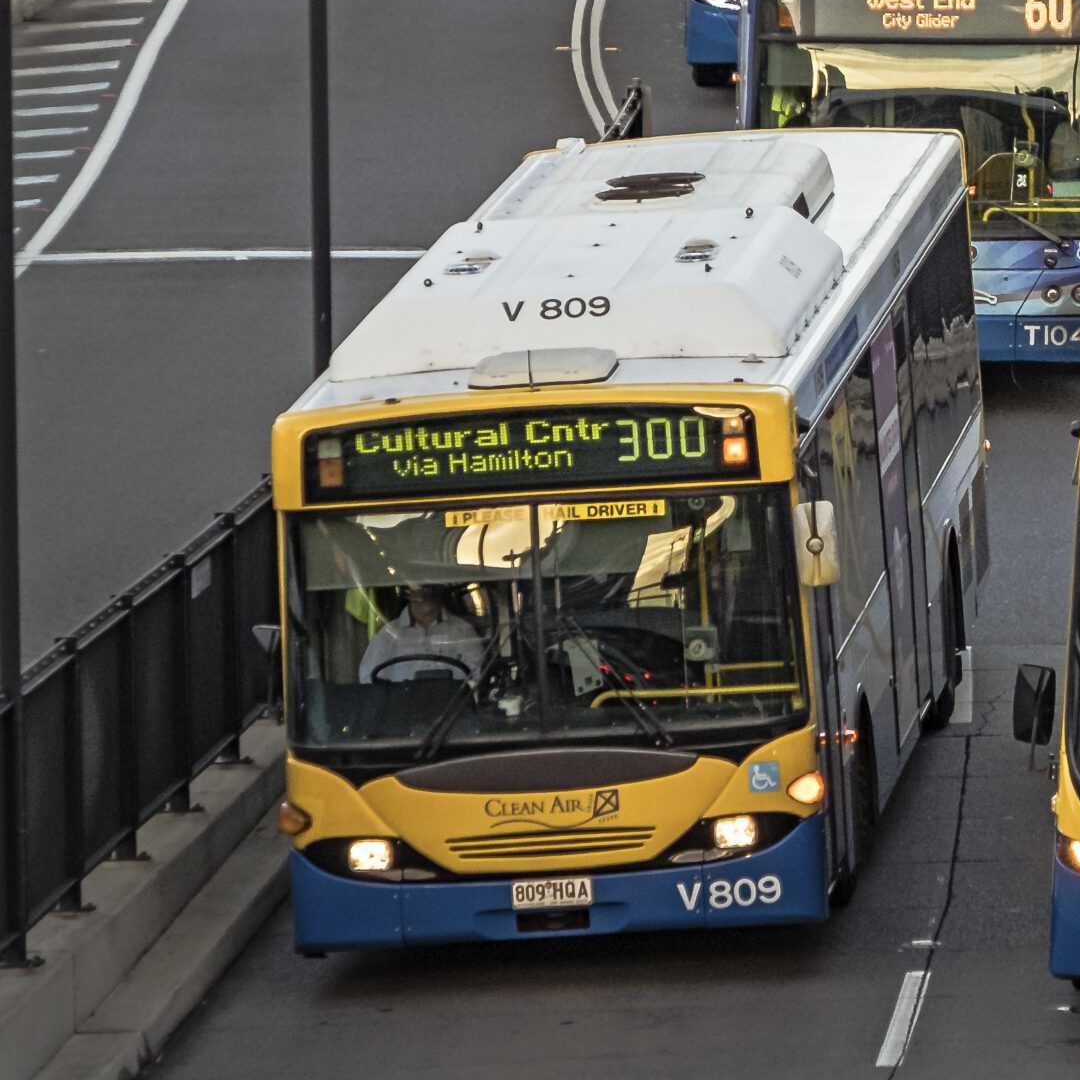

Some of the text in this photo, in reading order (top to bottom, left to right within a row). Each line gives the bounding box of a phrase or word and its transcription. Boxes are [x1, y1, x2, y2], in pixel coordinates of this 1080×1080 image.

[882, 12, 960, 30] City Glider
[540, 296, 611, 320] 809
[354, 415, 706, 462] Cultural Cntr 300
[393, 449, 574, 476] via Hamilton
[463, 503, 648, 526] PLEASE HAIL DRIVER
